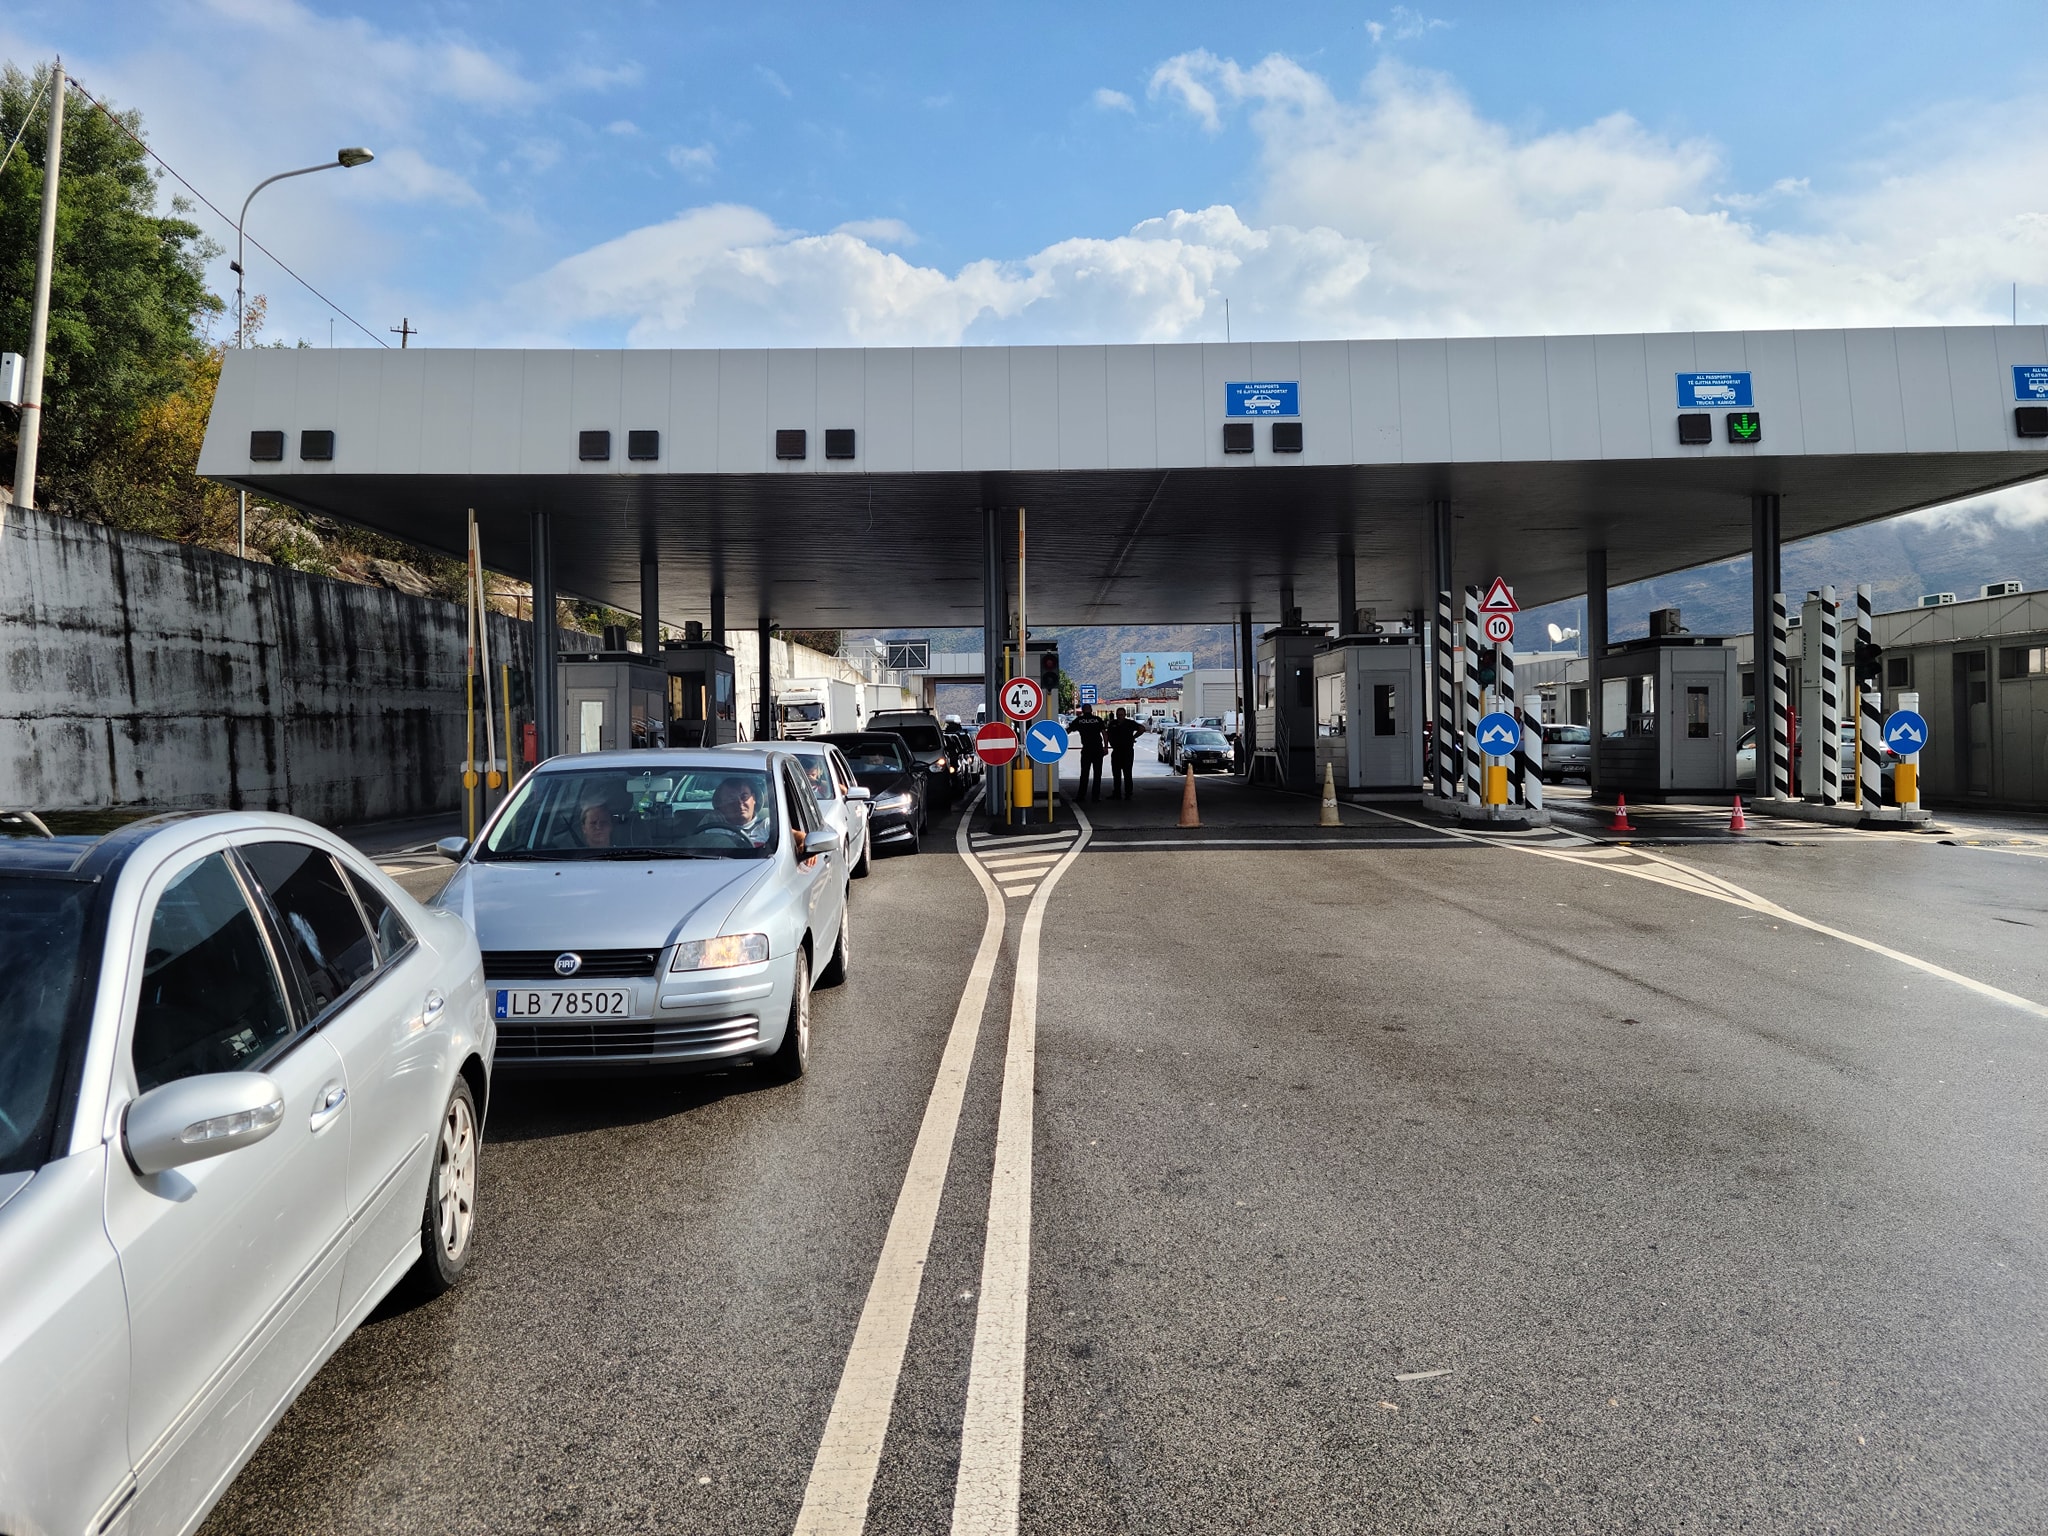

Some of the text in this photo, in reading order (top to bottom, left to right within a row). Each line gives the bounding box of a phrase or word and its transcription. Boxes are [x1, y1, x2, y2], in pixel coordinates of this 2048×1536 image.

[1492, 621, 1506, 635] 10
[1011, 690, 1021, 708] 4
[558, 959, 575, 969] FIAT
[497, 992, 624, 1015] PL LB 78502
